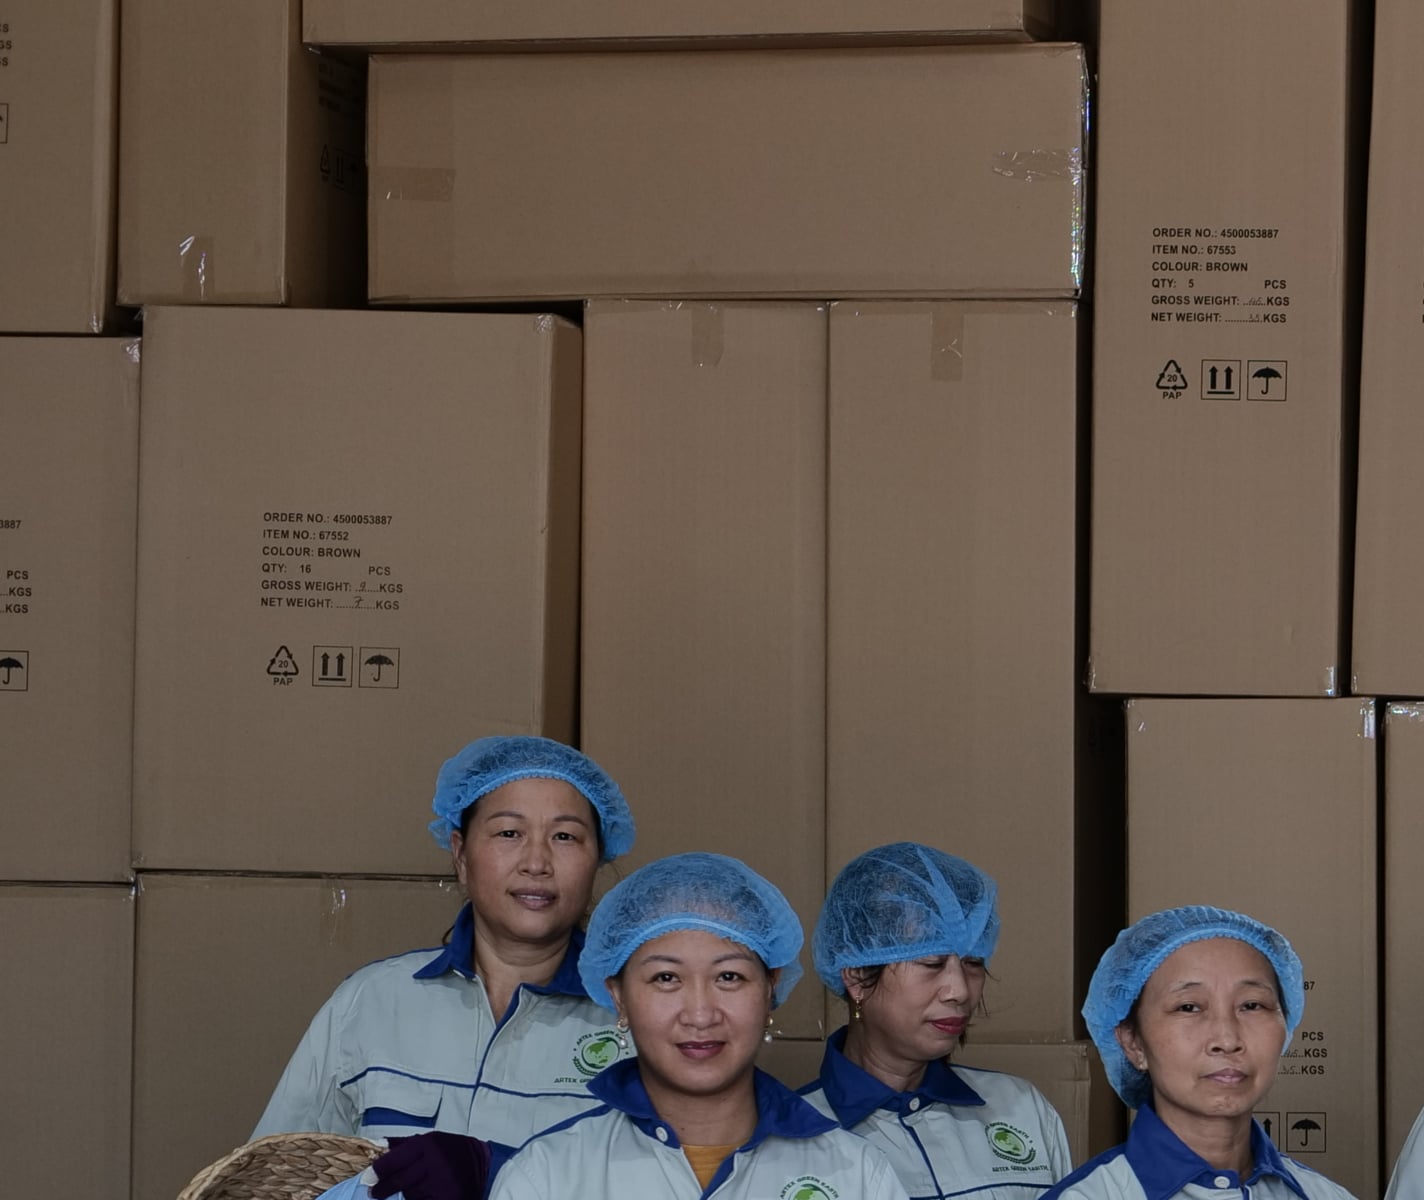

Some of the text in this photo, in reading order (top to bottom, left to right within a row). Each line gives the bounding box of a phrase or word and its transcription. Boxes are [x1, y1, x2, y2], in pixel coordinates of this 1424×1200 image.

[1152, 228, 1279, 238] ORDER NO.: 4500053887
[1152, 245, 1236, 255] ITEM NO.: 67553
[1152, 262, 1248, 272] COLOUR: BROWN
[1152, 278, 1287, 289] QTY: 5 PCS
[1151, 296, 1190, 305] GROSS
[1193, 296, 1239, 306] WEIGHT:
[1151, 312, 1173, 322] NET
[1176, 313, 1222, 322] WEIGHT:
[1162, 391, 1182, 399] PAP
[263, 513, 392, 525] ORDER NO.: 4500053887
[263, 529, 349, 540] ITEM NO.: 67552
[262, 546, 361, 558] COLOUR: BROWN
[262, 563, 391, 576] QTY: 16 PCS
[7, 570, 29, 580] PCS
[261, 580, 301, 590] GROSS
[305, 581, 352, 592] WEIGHT:
[261, 597, 283, 607] NET
[286, 598, 333, 608] WEIGHT:
[278, 660, 289, 668] 20
[273, 677, 293, 686] PAP
[1302, 1031, 1324, 1041] PCS
